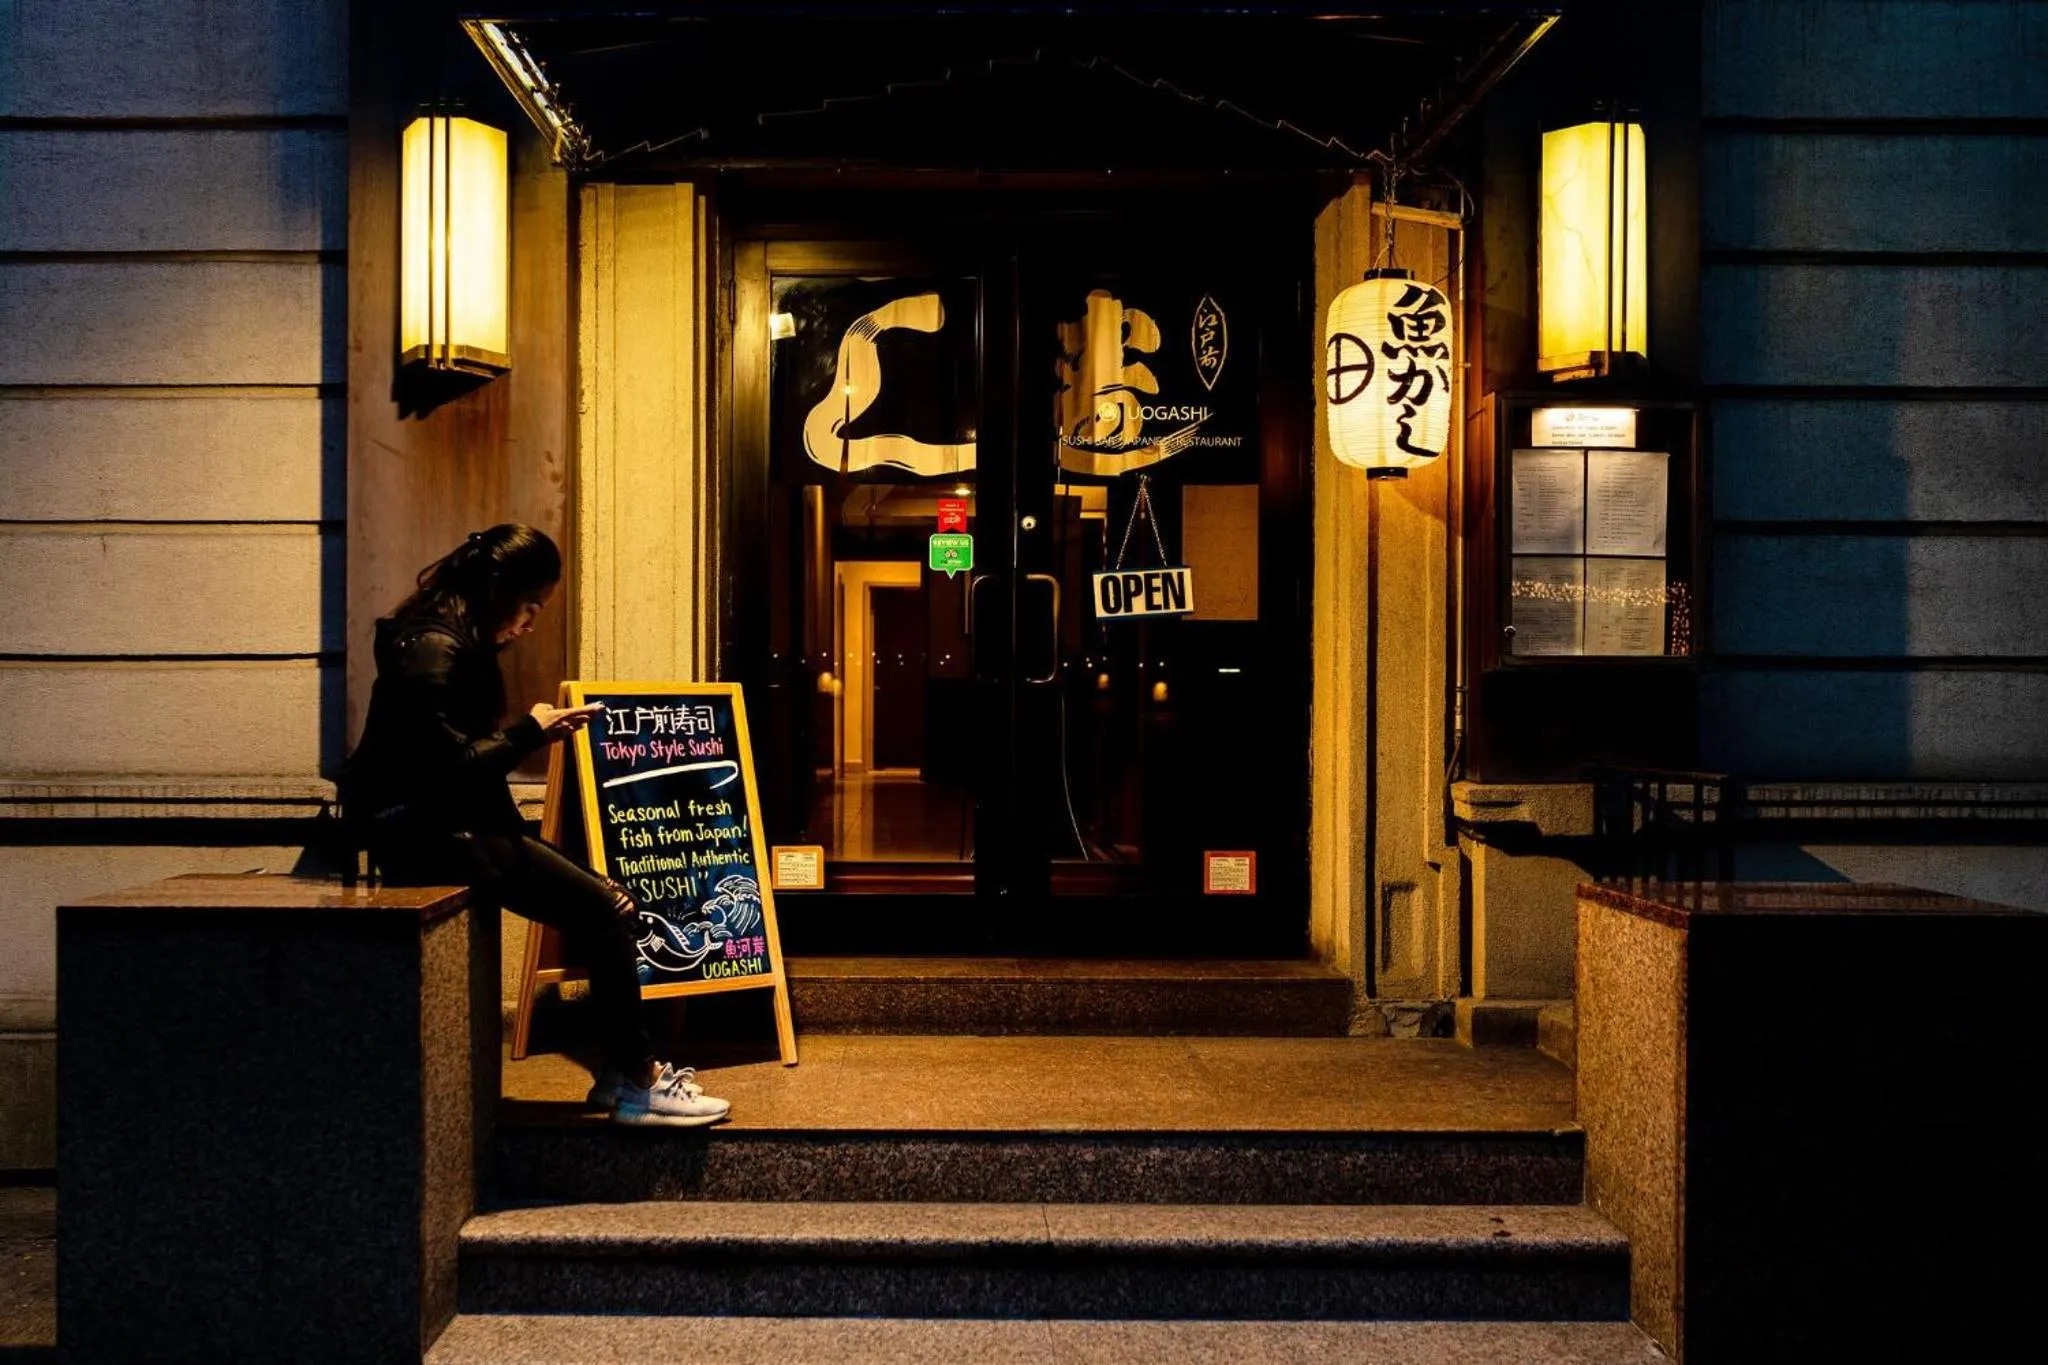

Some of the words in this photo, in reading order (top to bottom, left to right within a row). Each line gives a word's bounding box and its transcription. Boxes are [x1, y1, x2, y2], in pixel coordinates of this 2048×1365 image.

[1129, 405, 1209, 421] UOGASHI
[1062, 435, 1093, 447] SUSHI
[1100, 572, 1186, 614] OPEN
[600, 741, 647, 767] Tokyo
[650, 739, 686, 764] Style
[688, 737, 724, 756] Sushi
[608, 800, 681, 824] Seasonal
[688, 799, 732, 817] fresh
[619, 827, 653, 850] fish
[657, 826, 694, 846] from
[695, 814, 748, 847] Japan!
[616, 851, 687, 877] Traditional
[691, 848, 750, 869] Authentic
[702, 957, 763, 980] UOGASHI
